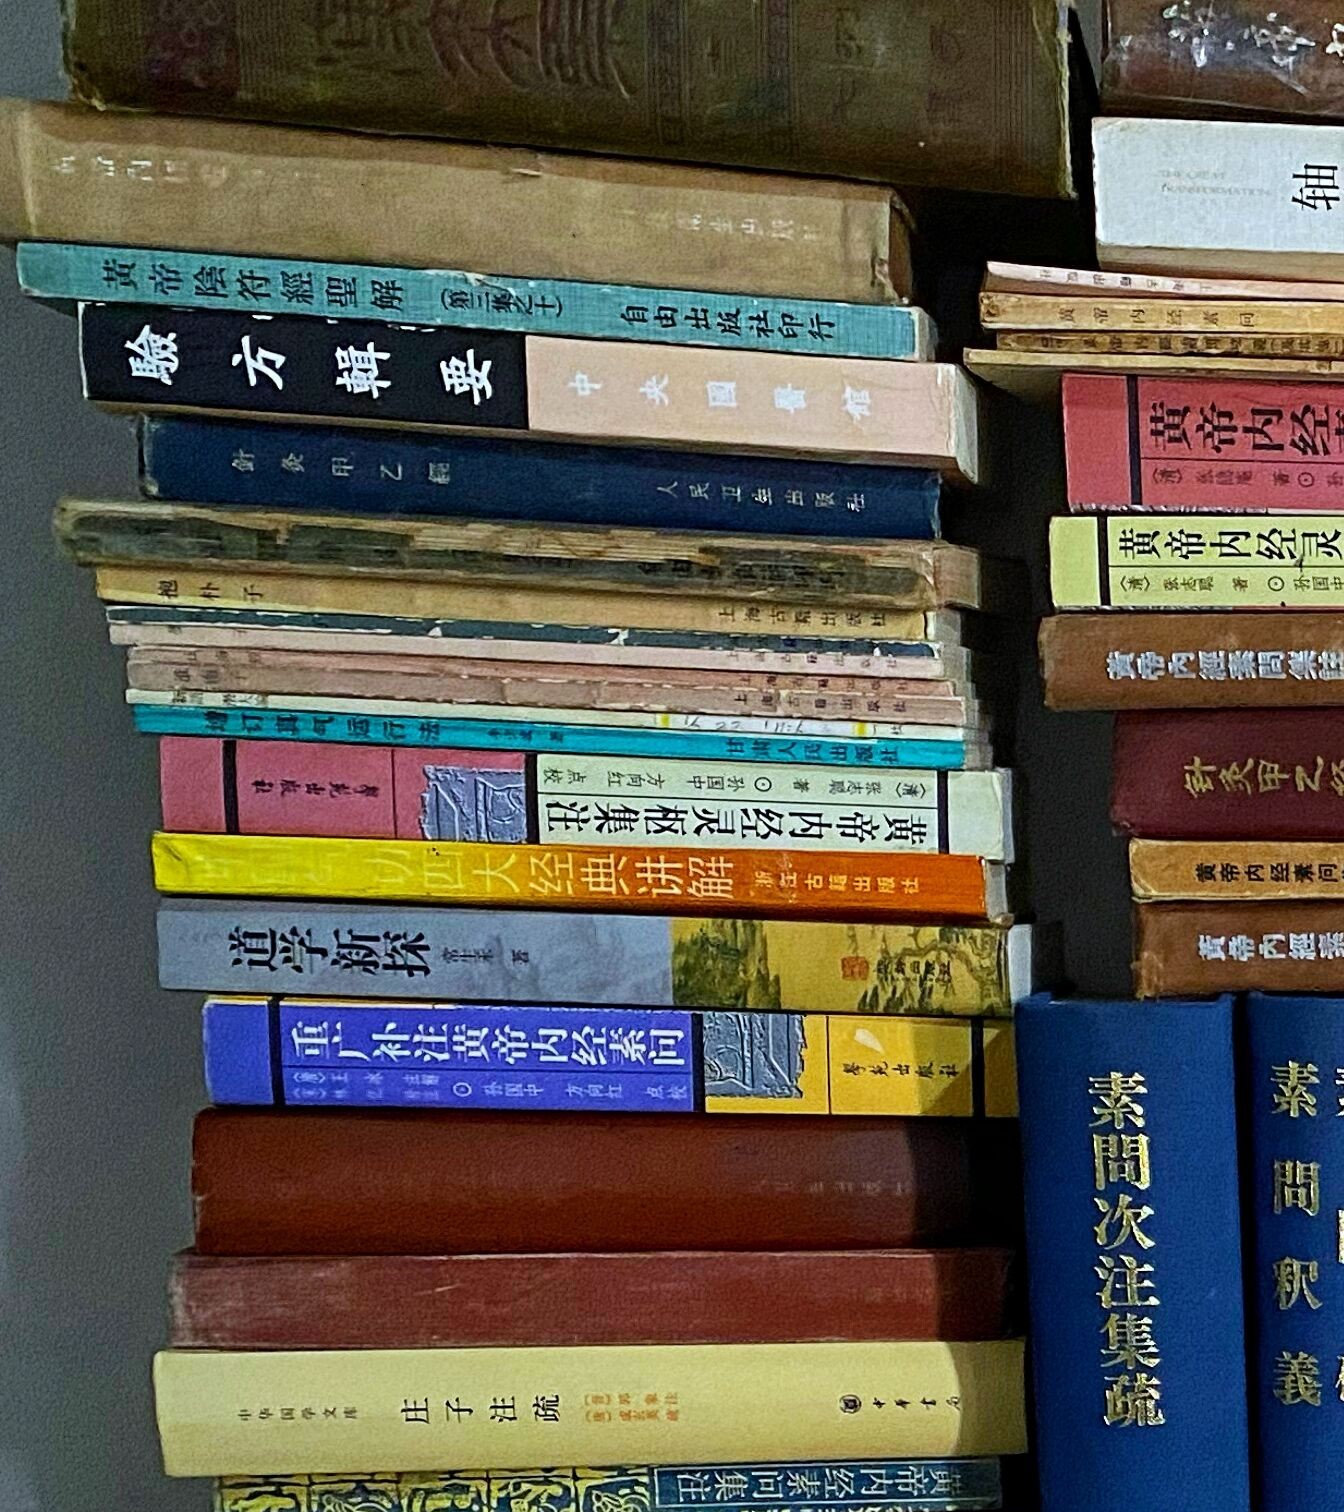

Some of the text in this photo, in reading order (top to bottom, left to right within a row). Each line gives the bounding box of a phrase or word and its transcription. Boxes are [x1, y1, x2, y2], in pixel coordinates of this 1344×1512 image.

[130, 324, 494, 406] 驗方輯要
[1163, 578, 1215, 593] 张志聪
[1232, 578, 1249, 591] 著
[228, 927, 431, 978] 道学新探
[1087, 1070, 1166, 1427] 素問次注集疏
[1271, 1059, 1321, 1407] 素問釈義
[401, 1396, 561, 1424] 庄子注疏
